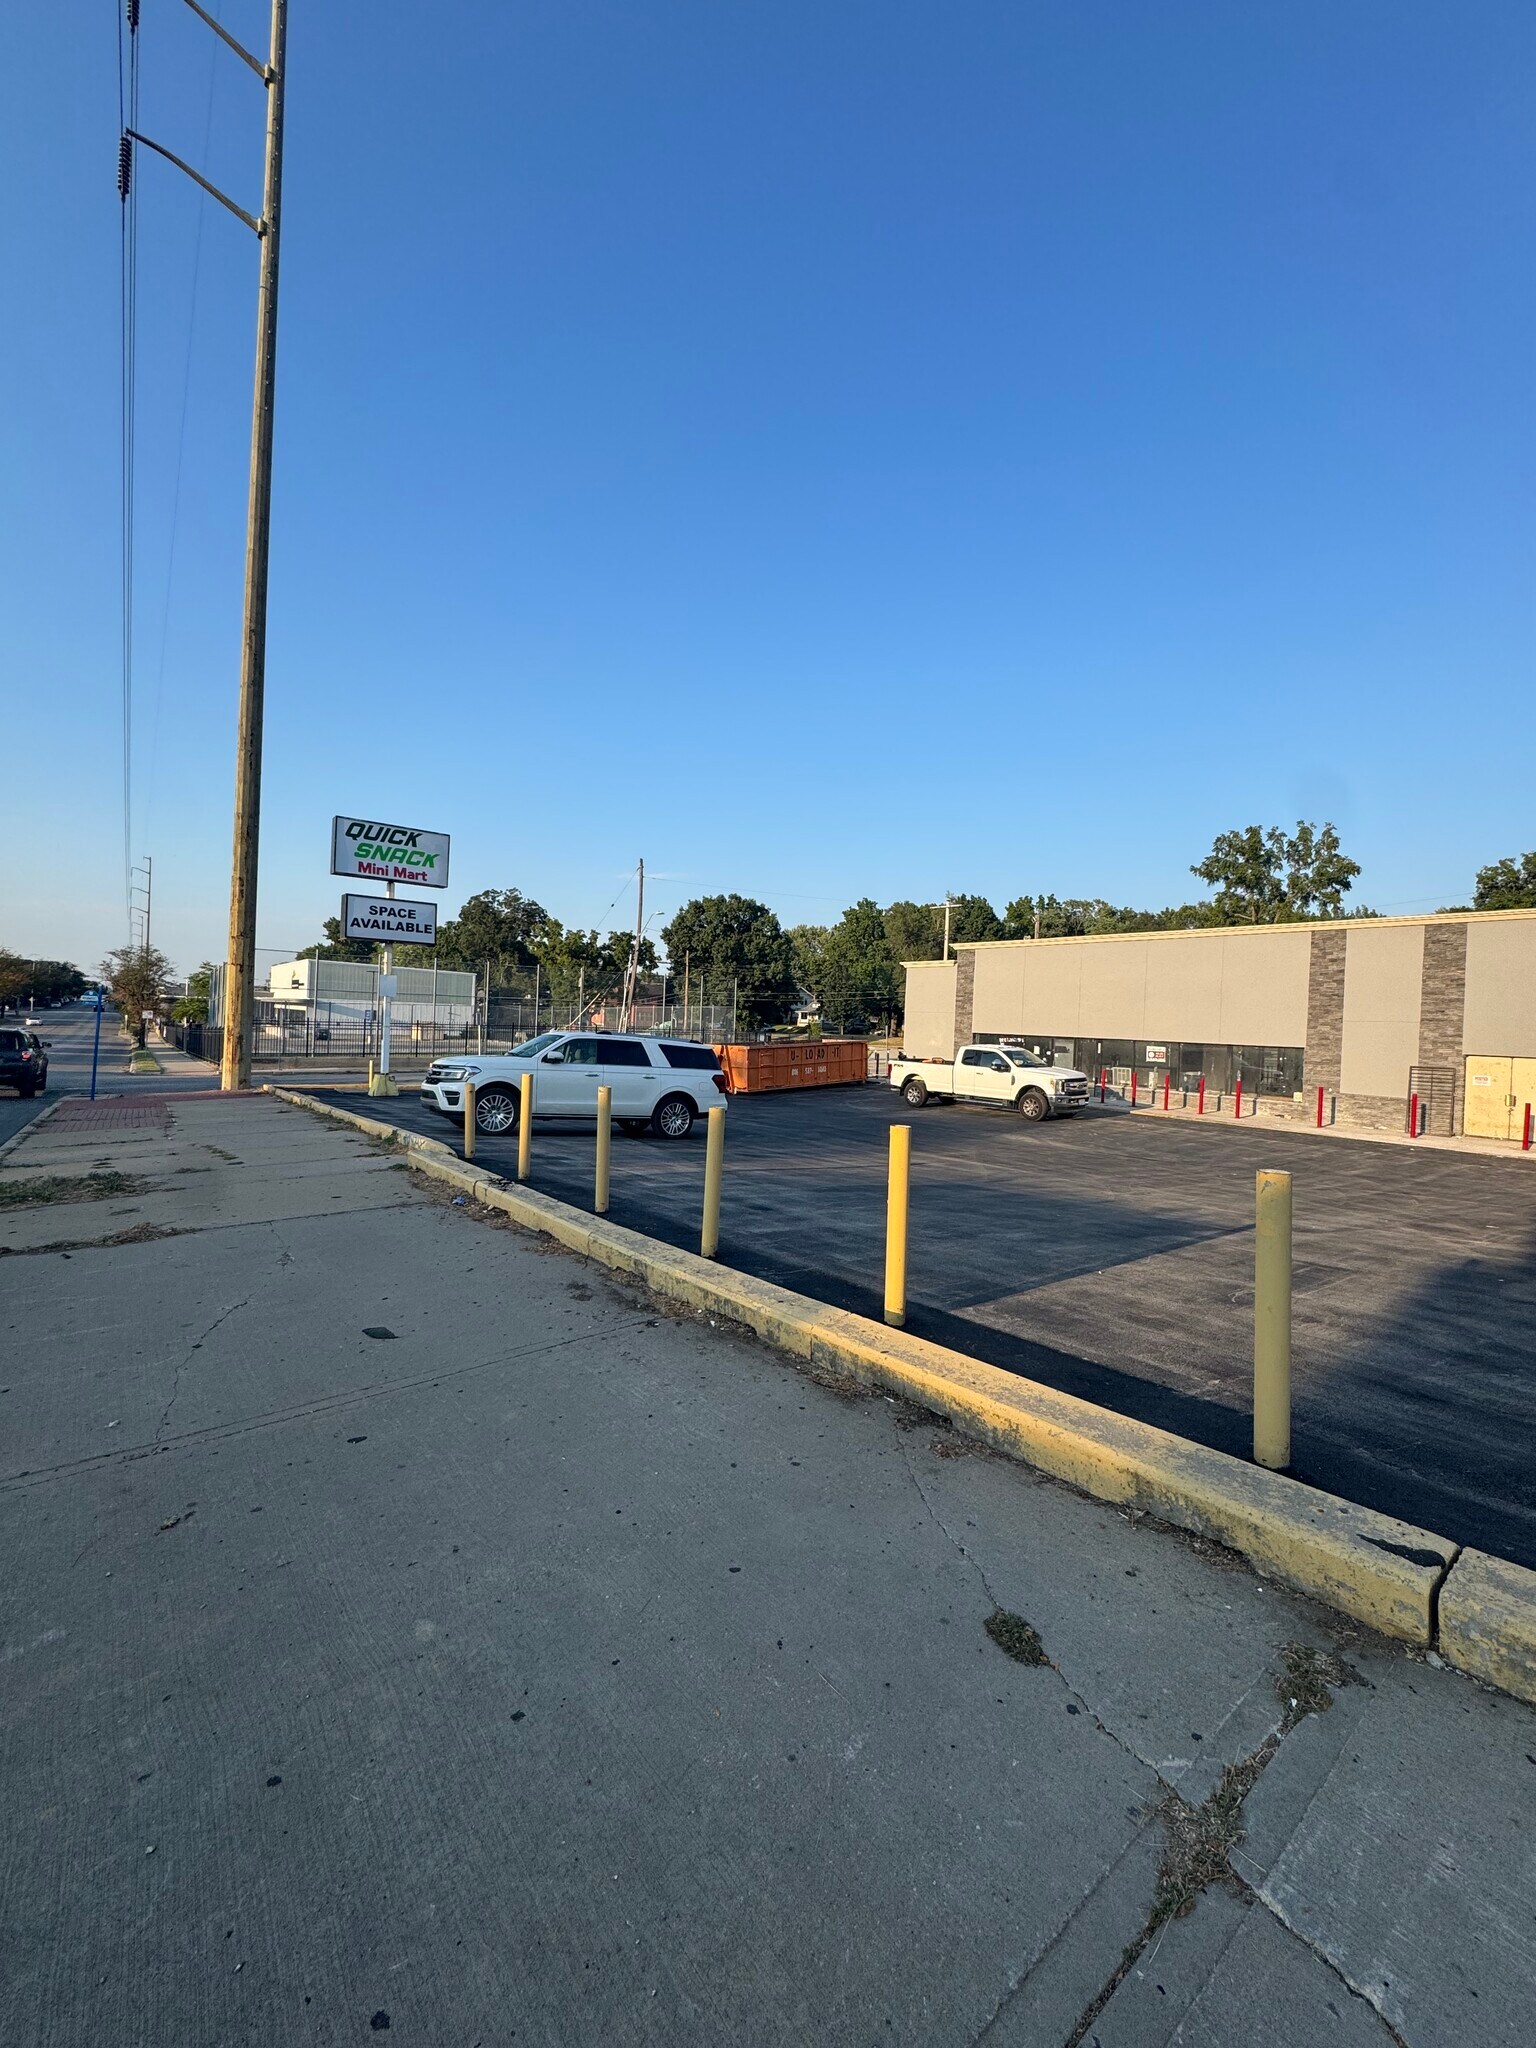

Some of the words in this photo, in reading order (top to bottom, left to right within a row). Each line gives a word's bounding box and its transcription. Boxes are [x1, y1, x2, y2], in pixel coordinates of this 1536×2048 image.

[345, 822, 422, 847] QUICK
[354, 842, 440, 868] SNACK
[358, 861, 389, 876] Mini
[393, 866, 428, 881] Mart
[369, 905, 417, 919] SPACE
[350, 917, 432, 934] AVAILABLE
